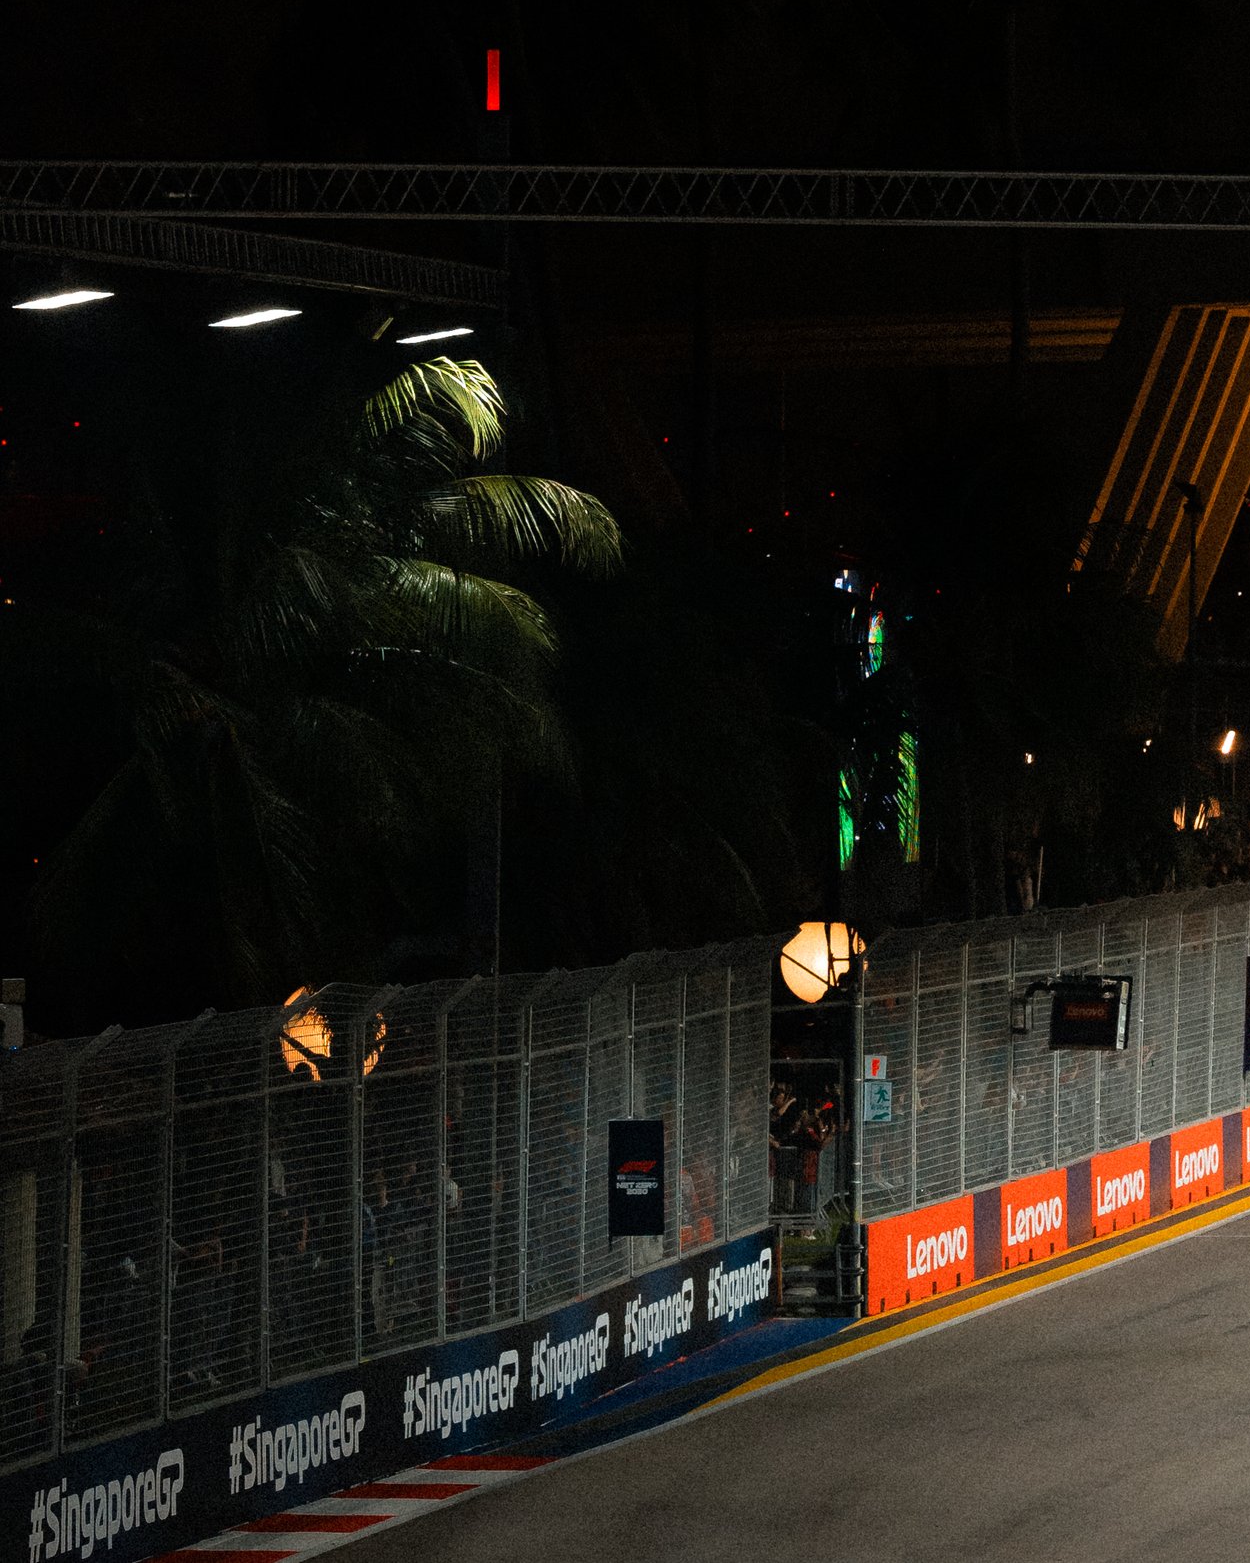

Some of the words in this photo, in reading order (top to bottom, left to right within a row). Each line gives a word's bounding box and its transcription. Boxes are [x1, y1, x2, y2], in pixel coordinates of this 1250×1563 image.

[1067, 1004, 1106, 1017] Lenovo
[1096, 1168, 1146, 1217] Lenovo
[1175, 1143, 1220, 1189] Lenovo
[906, 1225, 968, 1280] Lenovo
[1007, 1196, 1063, 1247] Lenovo
[624, 1277, 698, 1358] #SingaporeGP
[706, 1247, 772, 1323] #SingaporeGP
[403, 1349, 519, 1439] #SingaporeGP
[530, 1311, 610, 1401] #SingaporeGP
[228, 1390, 366, 1495] #SingaporeGP
[28, 1448, 185, 1563] #SingaporeGP
